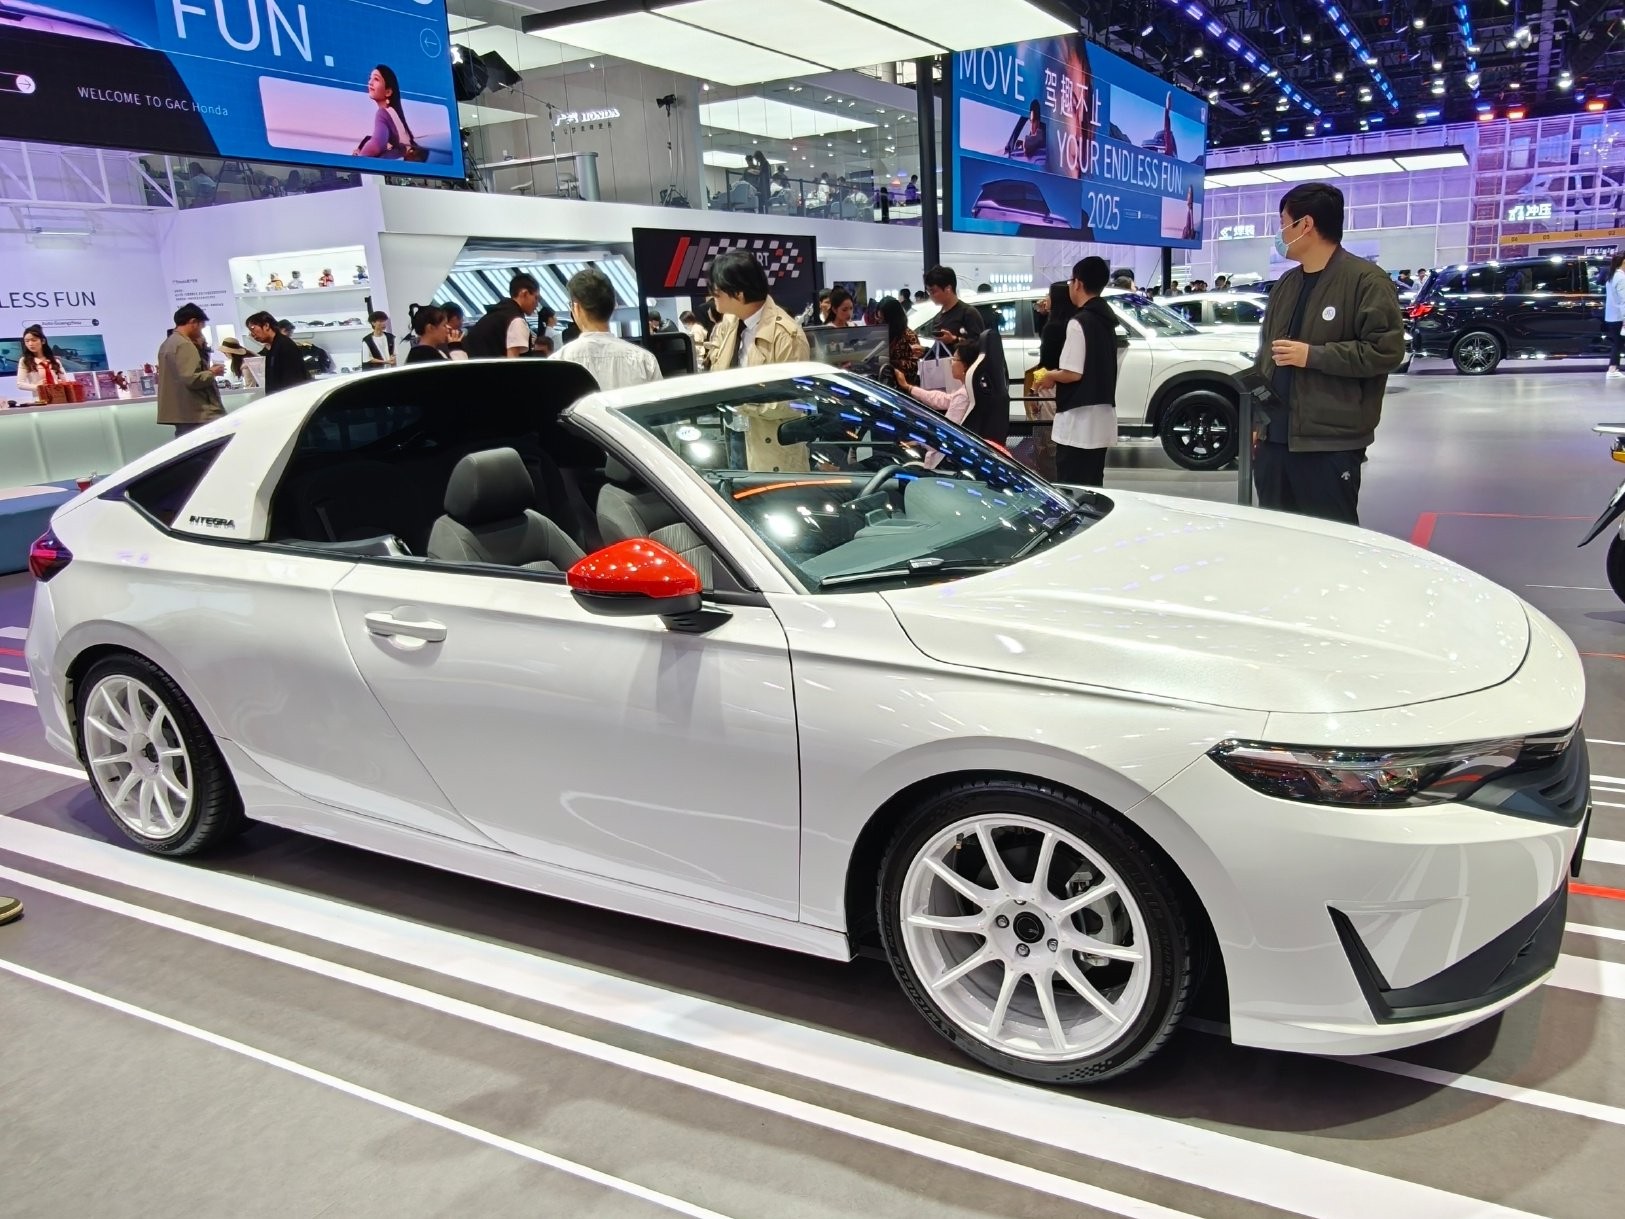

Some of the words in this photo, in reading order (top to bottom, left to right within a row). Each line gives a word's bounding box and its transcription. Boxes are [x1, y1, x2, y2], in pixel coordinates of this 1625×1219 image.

[171, 0, 335, 68] FUN.
[959, 47, 1026, 101] MOVE
[77, 86, 142, 106] WELCOME
[144, 95, 162, 108] TO
[165, 98, 190, 111] GAC
[191, 101, 229, 116] Honda
[1043, 67, 1102, 127] 驾趣不止
[1055, 129, 1101, 176] YOUR
[1103, 144, 1160, 190] ENDLESS
[1160, 161, 1184, 196] FUN.
[1087, 191, 1120, 231] 2025
[1525, 203, 1552, 217] 冲压
[53, 291, 96, 307] FUN
[189, 515, 236, 527] INTEGRA
